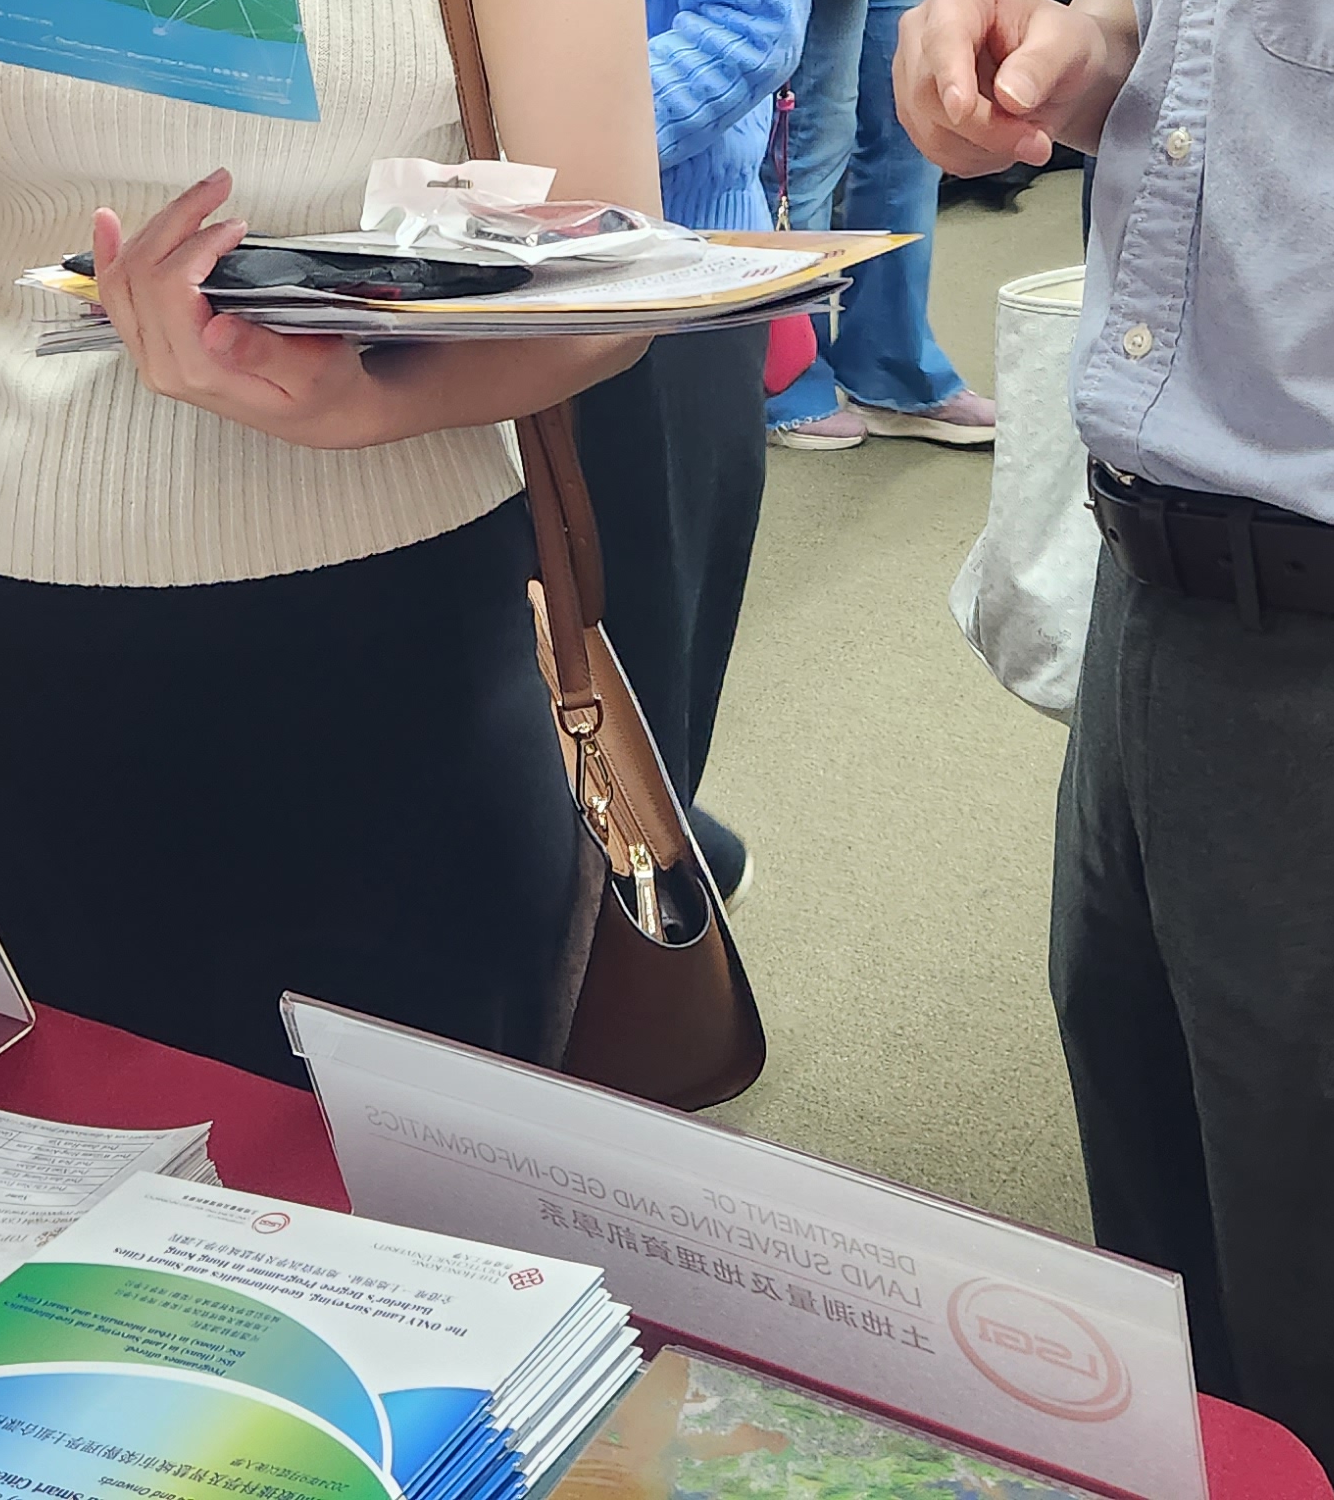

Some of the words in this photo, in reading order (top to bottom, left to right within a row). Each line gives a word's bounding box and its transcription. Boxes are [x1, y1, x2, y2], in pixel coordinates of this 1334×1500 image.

[112, 1247, 143, 1260] Cities
[162, 1245, 193, 1259] Kong
[144, 1255, 182, 1270] Smart
[197, 1253, 230, 1268] Hong
[232, 1263, 244, 1272] in
[183, 1265, 208, 1277] and
[246, 1265, 317, 1289] Programme
[210, 1271, 304, 1299] Geo-Informatics
[318, 1282, 364, 1300] Degree
[308, 1292, 372, 1314] Surveying,
[366, 1295, 433, 1316] Bachelor's
[1, 1301, 73, 1324] Geo-Informatics
[372, 1309, 405, 1322] Land
[74, 1320, 94, 1330] and
[405, 1316, 441, 1330] ONLY
[444, 1325, 467, 1336] The
[95, 1324, 141, 1342] Surveying
[142, 1338, 167, 1349] Land
[168, 1344, 179, 1352] in
[123, 1345, 161, 1359] offered:
[180, 1346, 214, 1361] (Hons)
[162, 1353, 226, 1375] Programmes
[215, 1357, 235, 1367] BSc
[32, 1481, 83, 1500] Smart
[96, 1475, 150, 1496] Onwards
